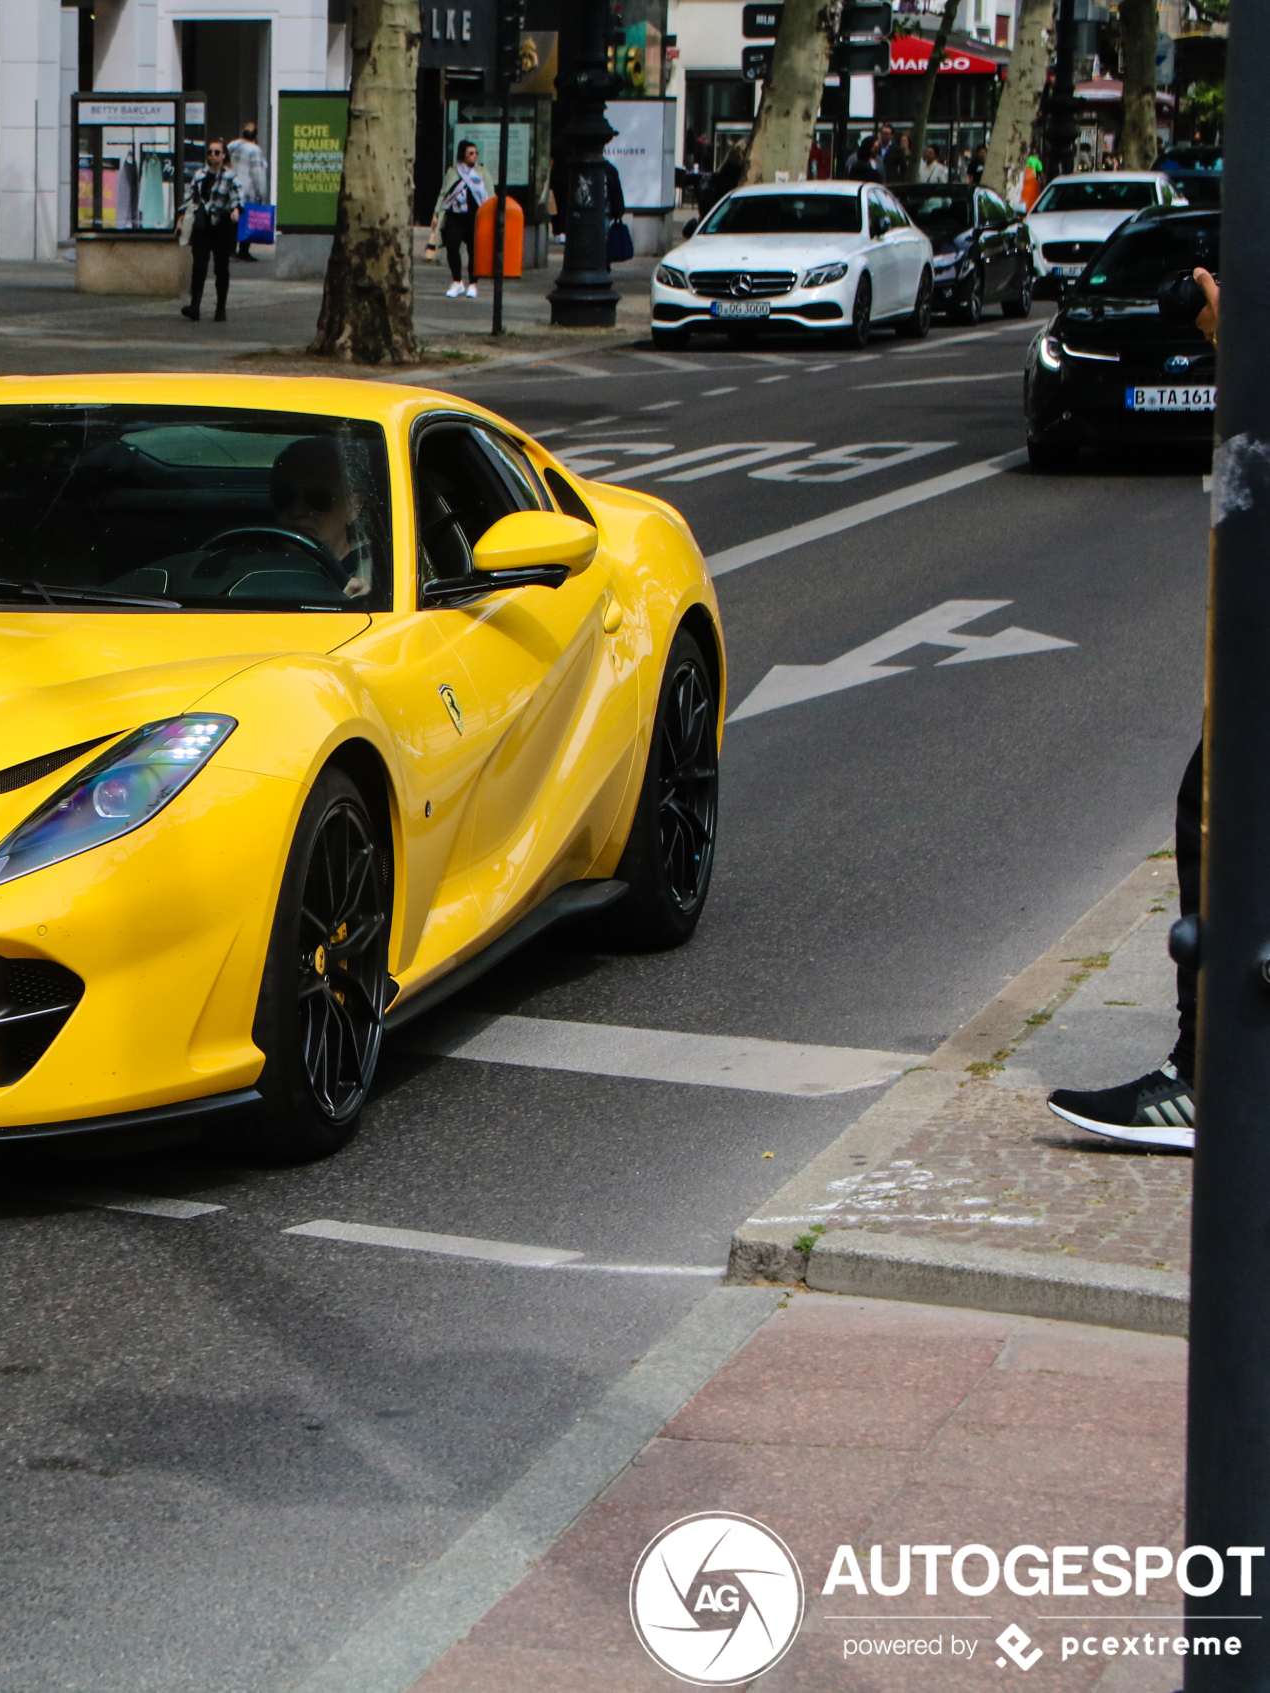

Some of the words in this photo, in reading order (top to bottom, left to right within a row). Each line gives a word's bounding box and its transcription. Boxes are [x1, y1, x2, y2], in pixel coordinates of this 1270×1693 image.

[890, 57, 970, 71] MARDO
[91, 105, 118, 115] BETTY
[121, 105, 161, 116] BARCLAY
[293, 124, 329, 137] ECHTE
[293, 138, 340, 151] FRAUEN
[1135, 390, 1145, 404] B
[1157, 390, 1178, 405] TA
